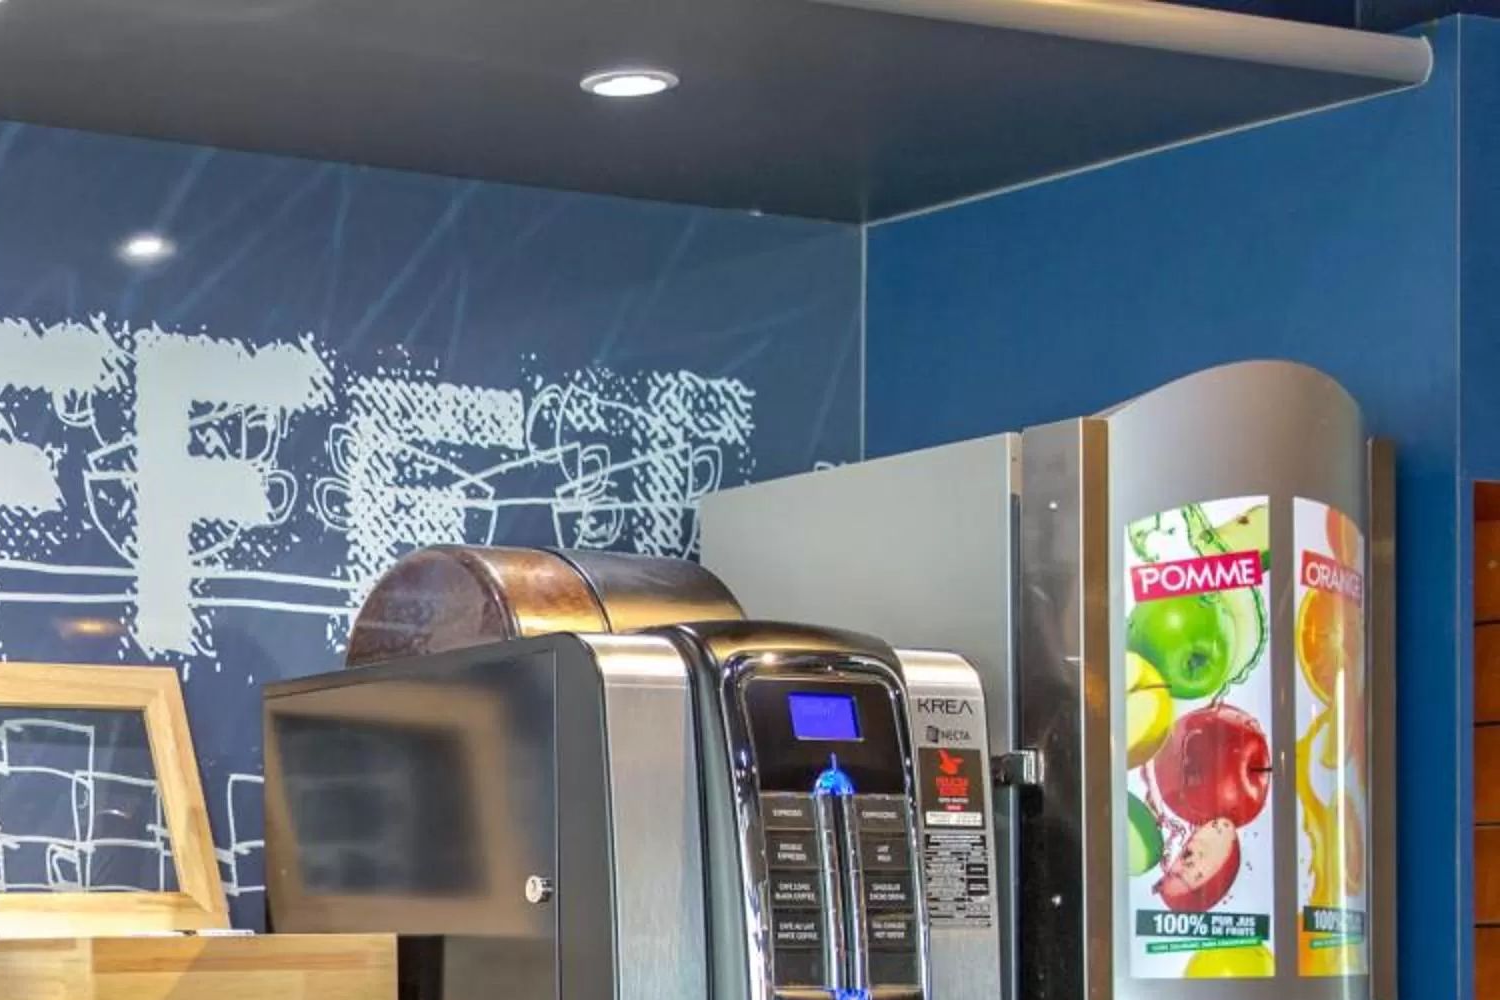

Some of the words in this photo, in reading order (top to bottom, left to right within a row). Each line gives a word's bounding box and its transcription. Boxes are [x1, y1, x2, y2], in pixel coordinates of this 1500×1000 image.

[1137, 557, 1256, 594] POMME
[1305, 561, 1361, 598] ORANGE
[916, 697, 973, 715] KREA
[1152, 913, 1208, 936] 100%
[1235, 916, 1256, 927] JUS
